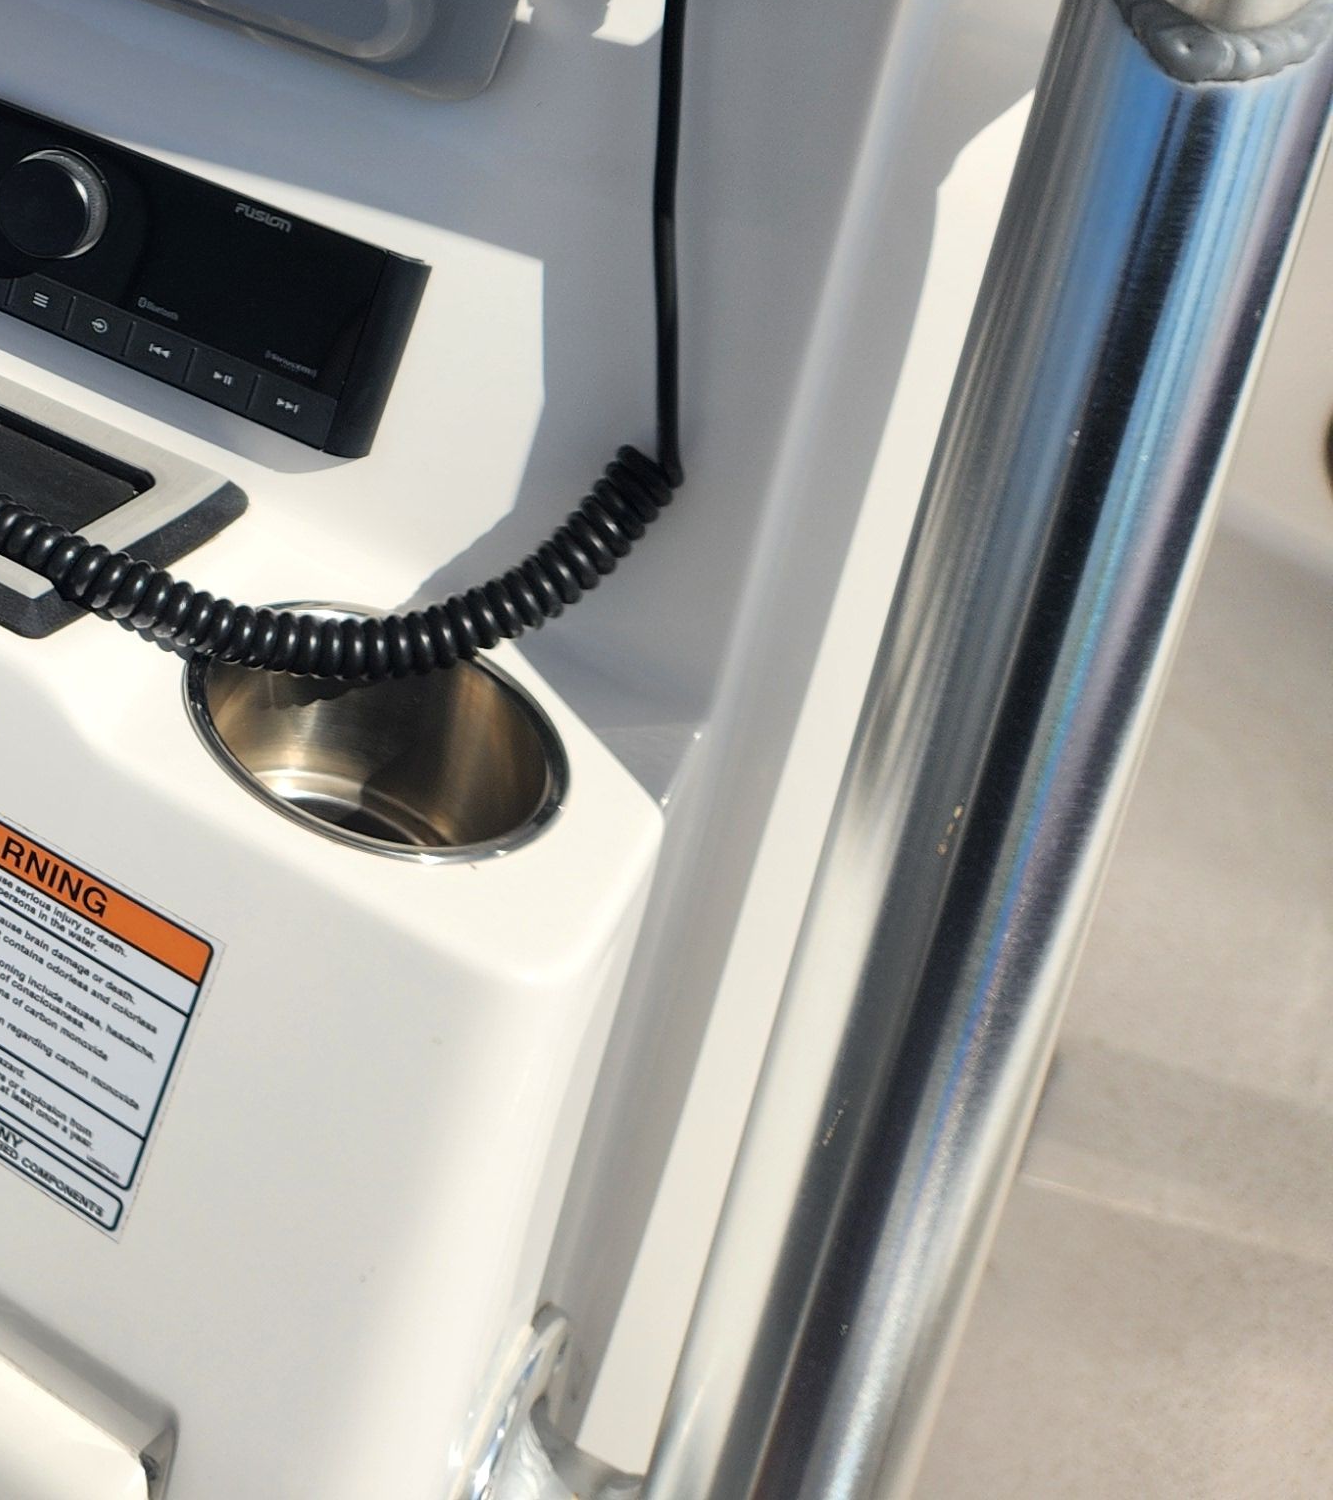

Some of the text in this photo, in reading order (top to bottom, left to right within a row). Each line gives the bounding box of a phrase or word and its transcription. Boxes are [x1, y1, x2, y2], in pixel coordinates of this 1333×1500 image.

[14, 882, 52, 912] serious
[2, 932, 45, 965] contains
[23, 929, 50, 952] brain
[27, 975, 64, 1004] include
[11, 994, 23, 1008] of
[23, 1001, 59, 1030] carbon
[5, 1019, 54, 1058] regarding
[20, 1156, 103, 1218] COMPONENTS
